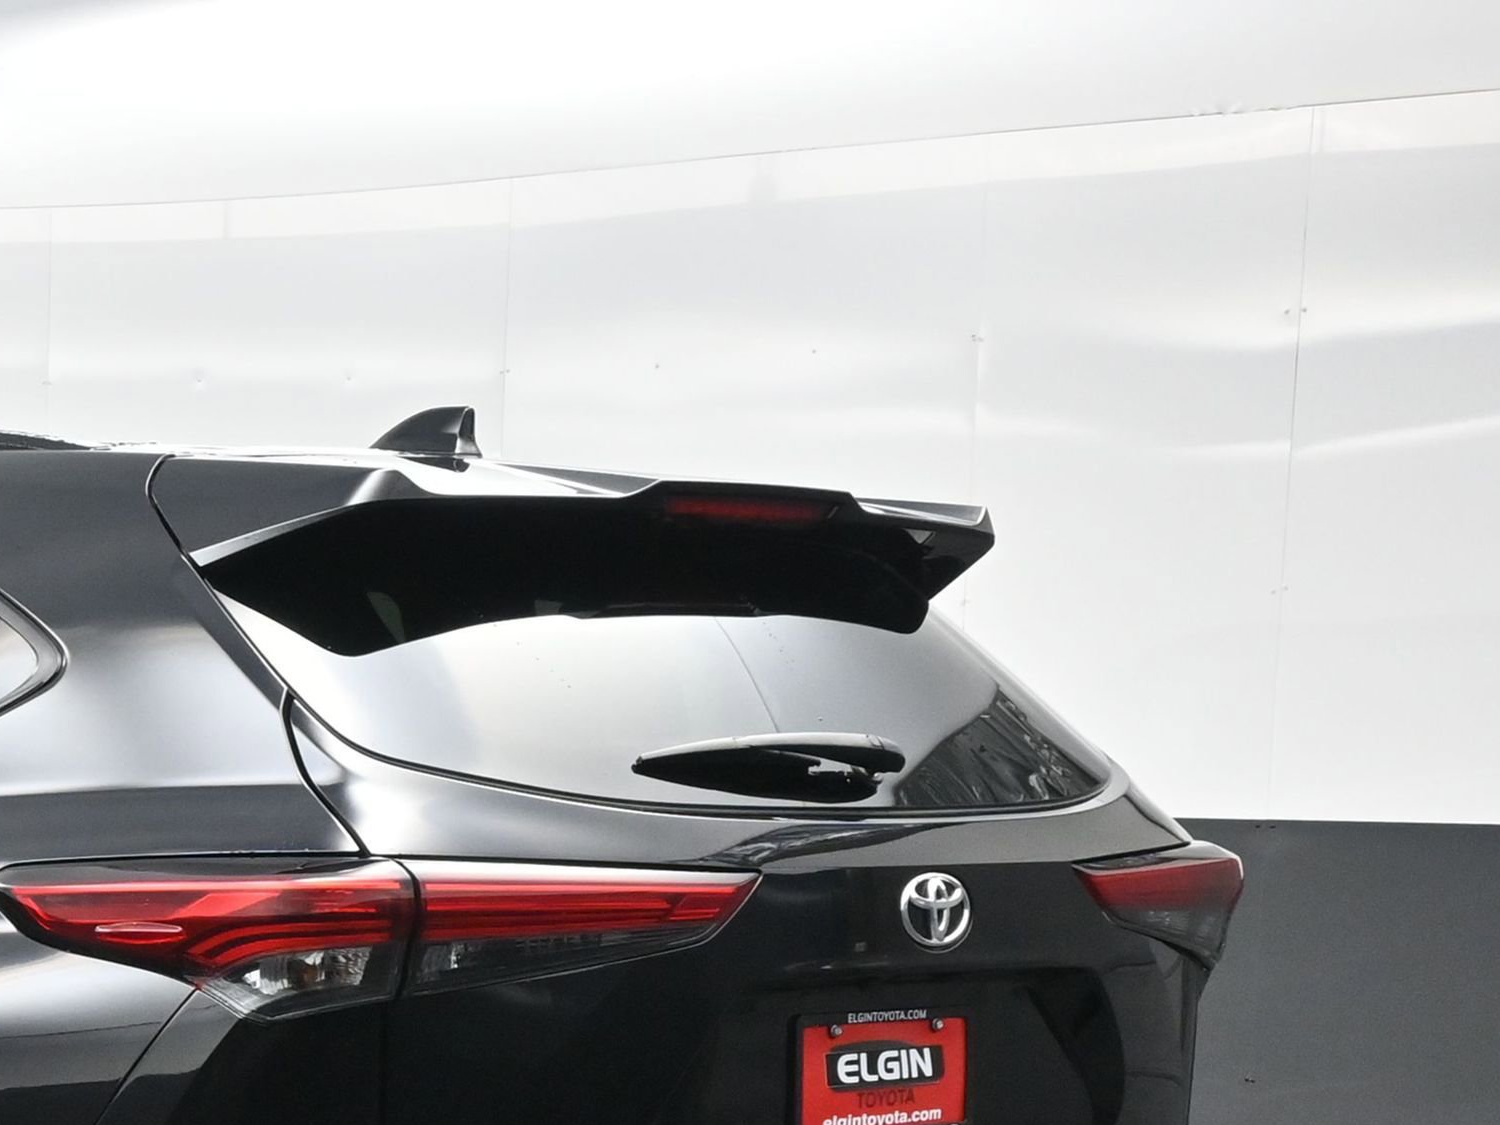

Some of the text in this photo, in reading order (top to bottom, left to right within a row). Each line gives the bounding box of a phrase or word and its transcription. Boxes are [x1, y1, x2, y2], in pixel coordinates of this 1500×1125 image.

[847, 1009, 928, 1024] ELGINTOYOTA.COM
[836, 1047, 934, 1084] ELGIN
[857, 1089, 915, 1109] TOYOTA
